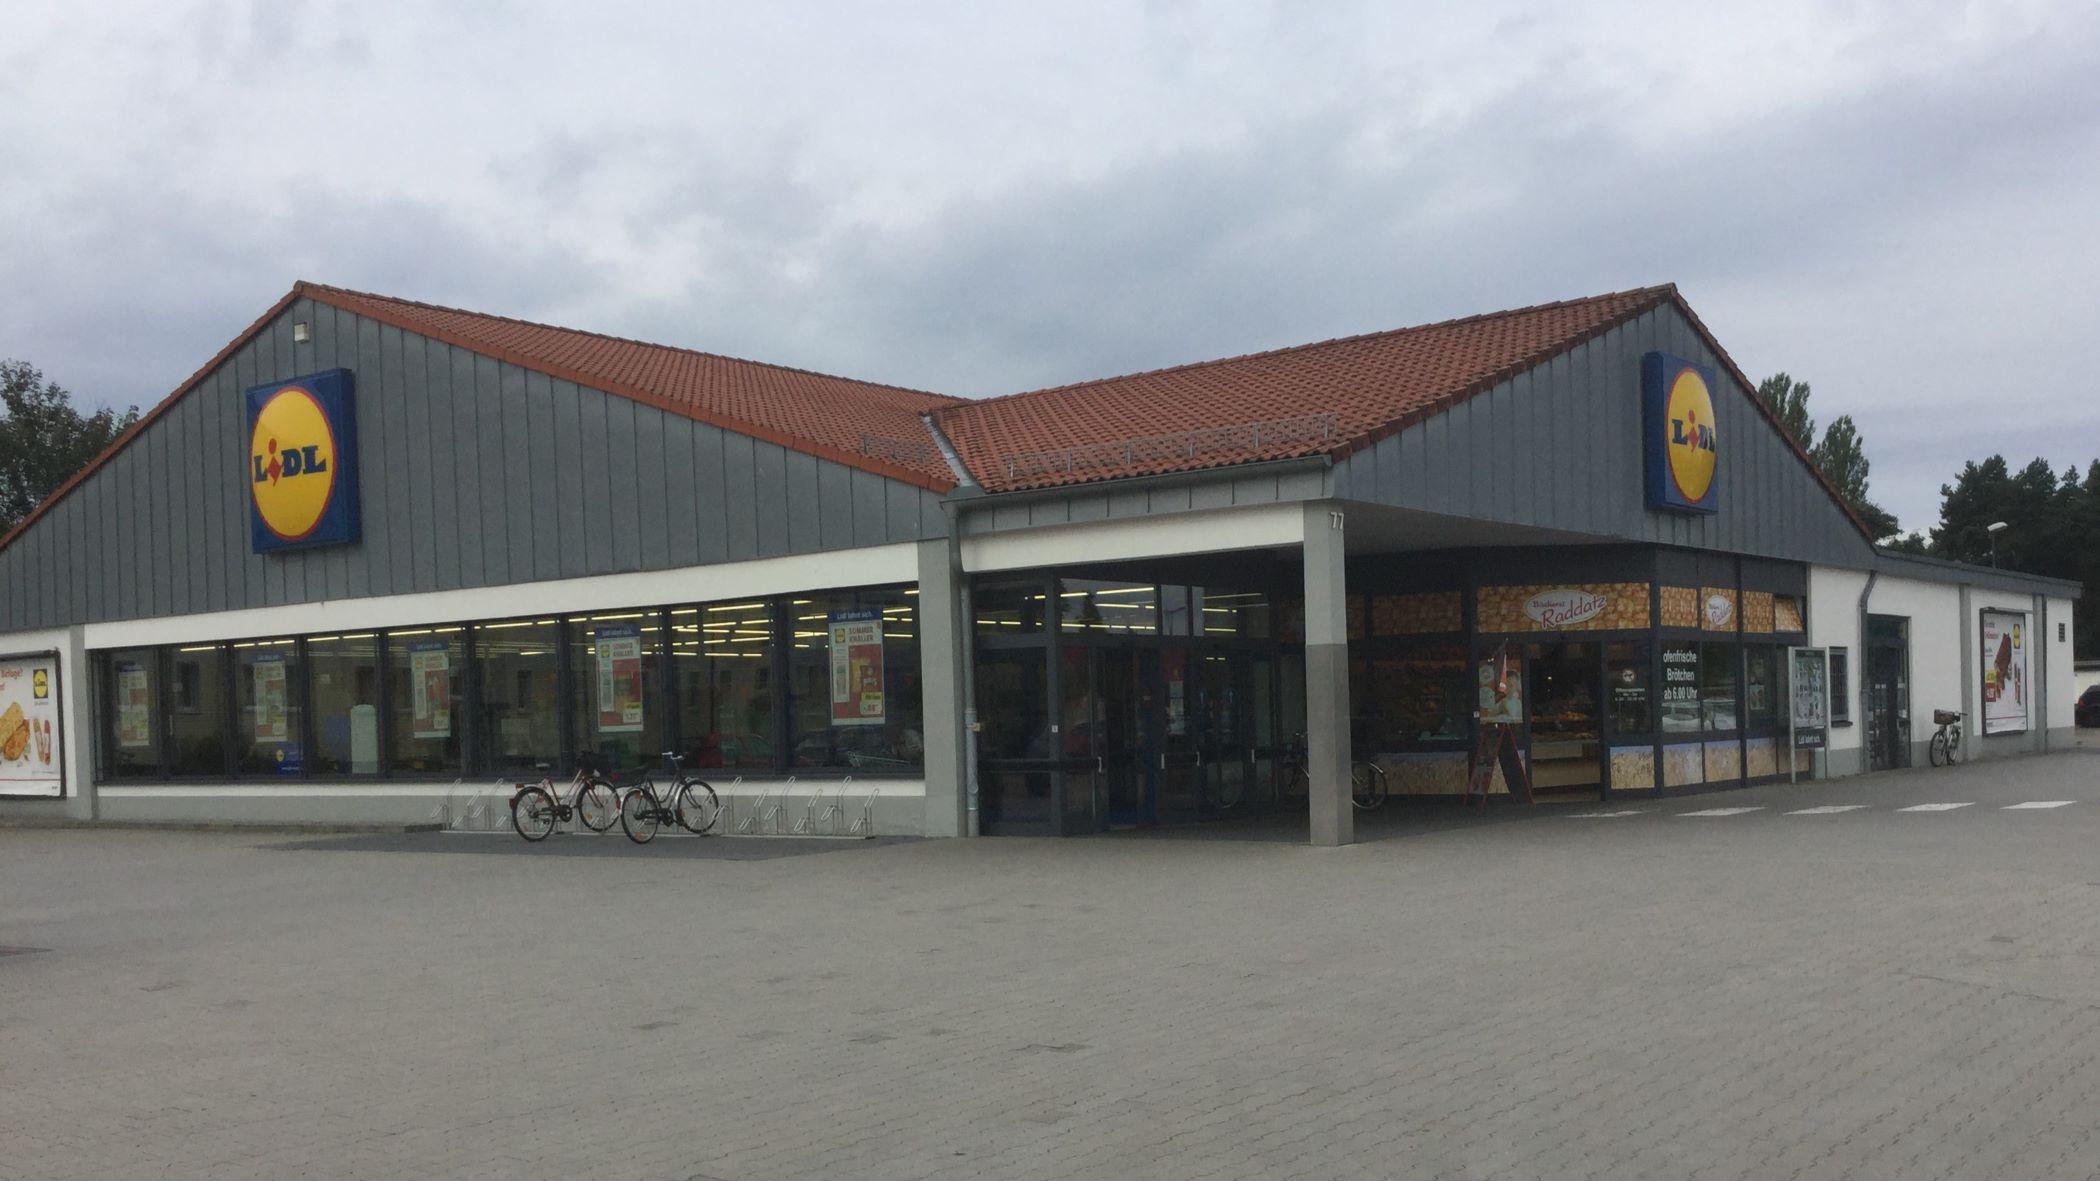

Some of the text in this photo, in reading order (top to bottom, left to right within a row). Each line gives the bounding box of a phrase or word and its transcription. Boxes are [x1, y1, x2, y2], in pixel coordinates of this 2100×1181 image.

[1330, 511, 1344, 529] 77
[1541, 595, 1607, 628] Raddatz
[1662, 649, 1697, 663] ofenfrische
[1666, 667, 1695, 681] Brötchen
[1663, 686, 1698, 700] ab 6.00 Uhr
